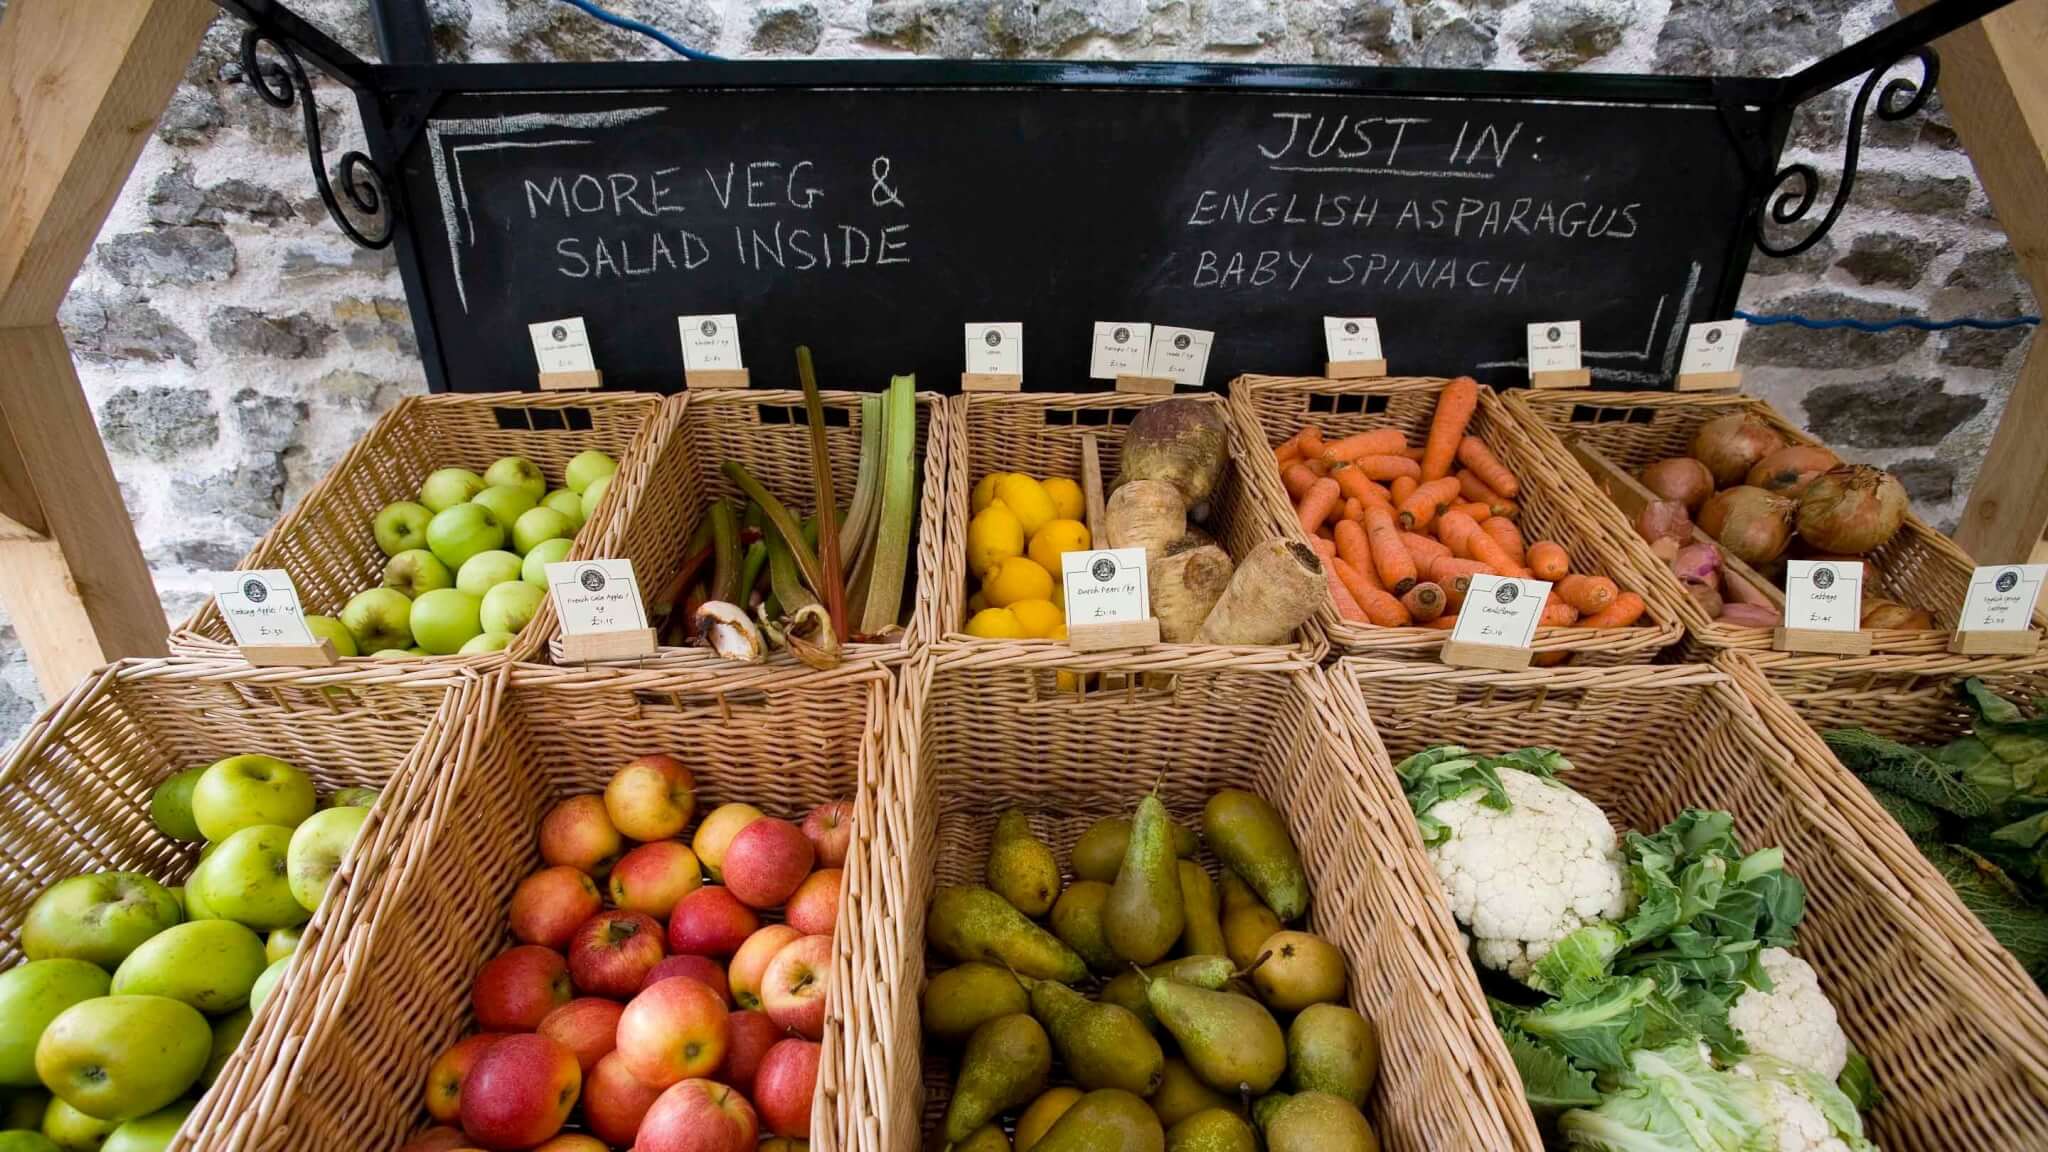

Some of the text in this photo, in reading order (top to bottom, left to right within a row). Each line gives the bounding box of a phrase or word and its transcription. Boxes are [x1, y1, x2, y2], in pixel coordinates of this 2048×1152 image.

[1257, 113, 1432, 166] JUST
[524, 155, 905, 218] MORE VEG &
[1187, 188, 1641, 238] ENGLISH ASPARAGUS
[555, 220, 911, 278] SALAD INSIDE
[1193, 250, 1527, 296] BABY SPINACH
